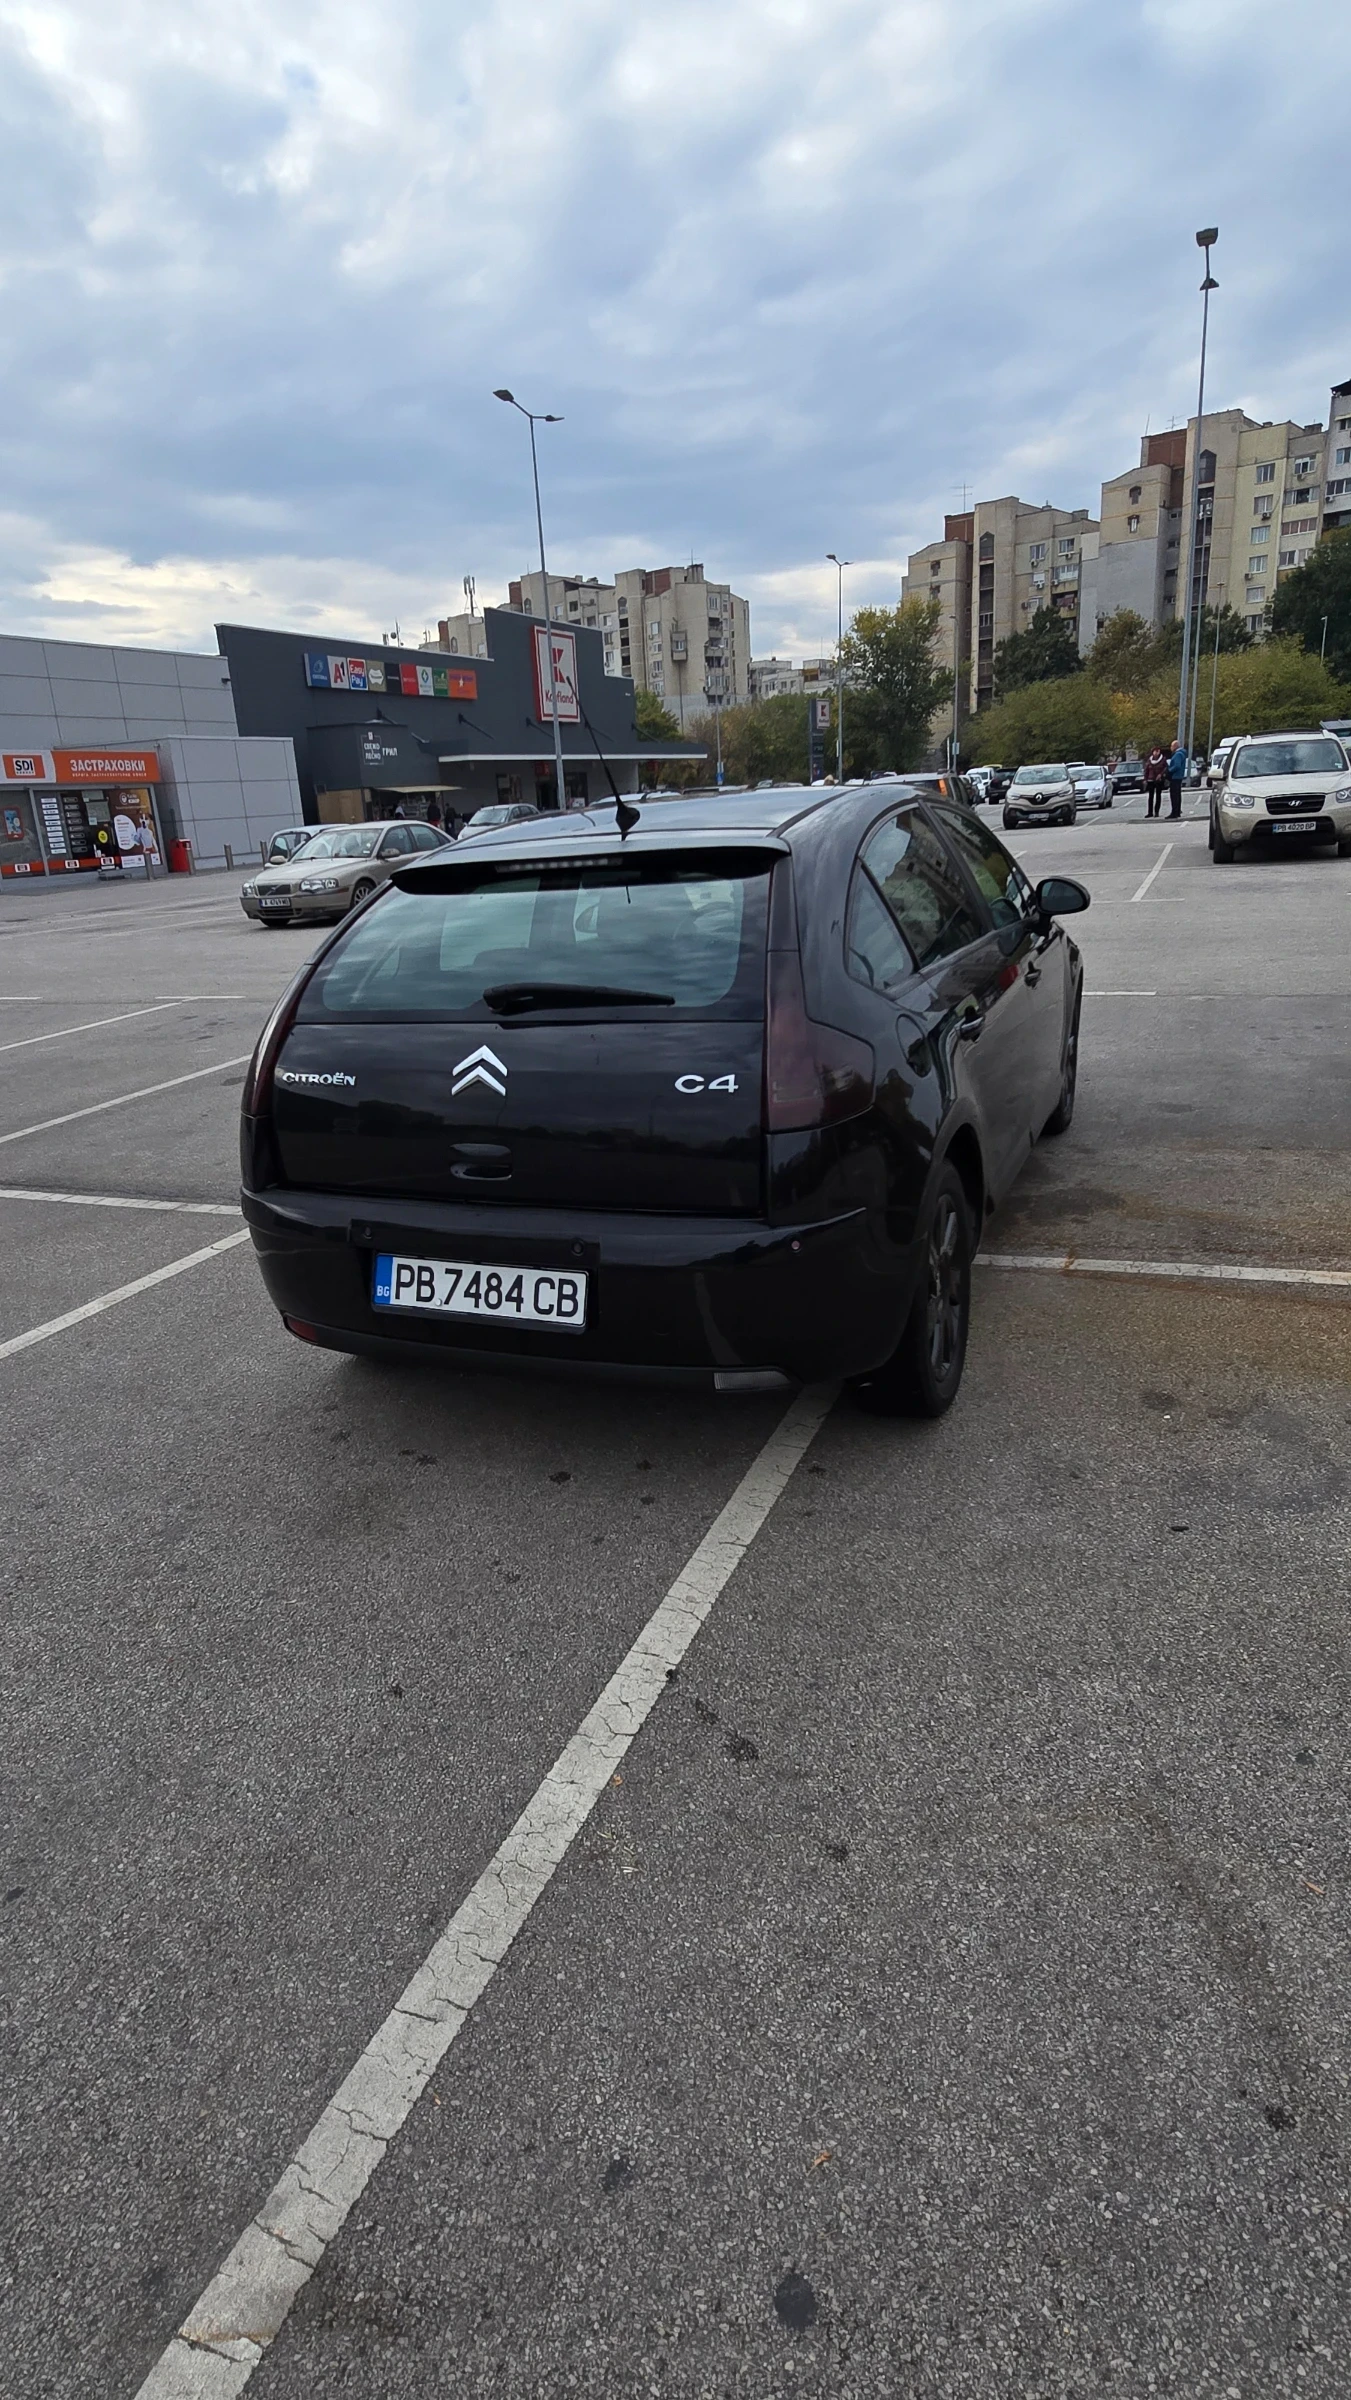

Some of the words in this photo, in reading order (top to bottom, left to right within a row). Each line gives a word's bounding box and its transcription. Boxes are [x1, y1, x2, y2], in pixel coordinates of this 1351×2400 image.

[350, 664, 364, 676] Easy
[351, 674, 364, 688] Pay
[545, 690, 574, 704] Kafland
[15, 760, 33, 771] SDI
[70, 759, 146, 771] ЗАСТРАХОВКИ
[282, 1072, 357, 1086] CITROËN
[674, 1073, 739, 1094] C4
[376, 1285, 390, 1297] BG
[395, 1263, 435, 1303] PB
[443, 1268, 524, 1313] 7484
[533, 1276, 579, 1318] CB
